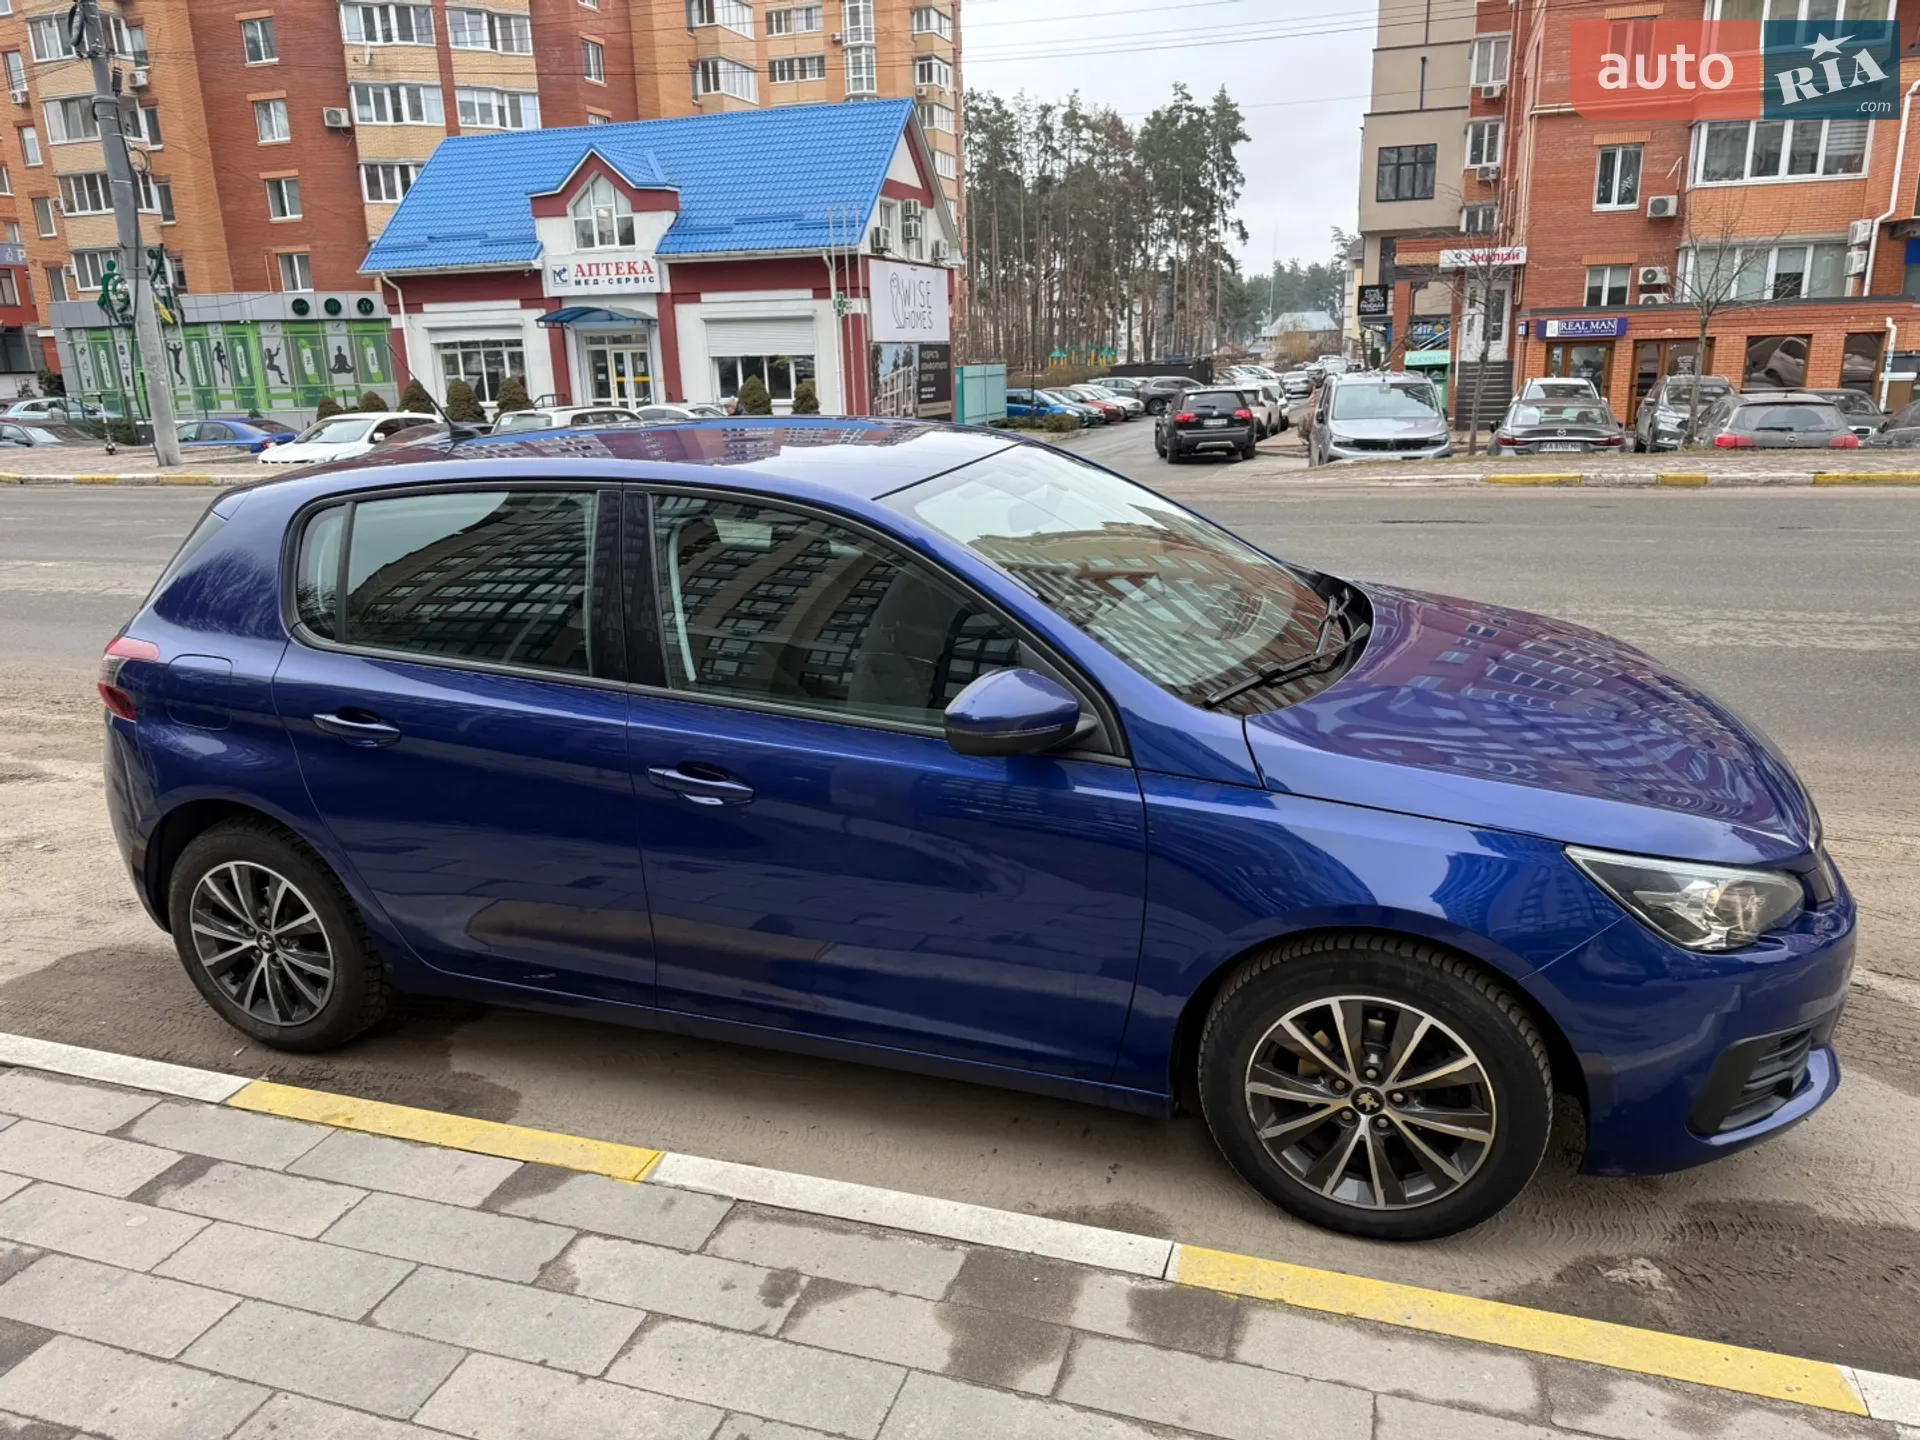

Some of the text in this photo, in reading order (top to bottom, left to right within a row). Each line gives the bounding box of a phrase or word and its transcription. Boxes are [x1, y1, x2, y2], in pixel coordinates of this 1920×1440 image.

[574, 260, 653, 277] АПТЕКА
[901, 278, 932, 309] WISE
[904, 310, 933, 329] HOMES
[1561, 321, 1587, 331] REAL
[1590, 320, 1616, 330] MAN
